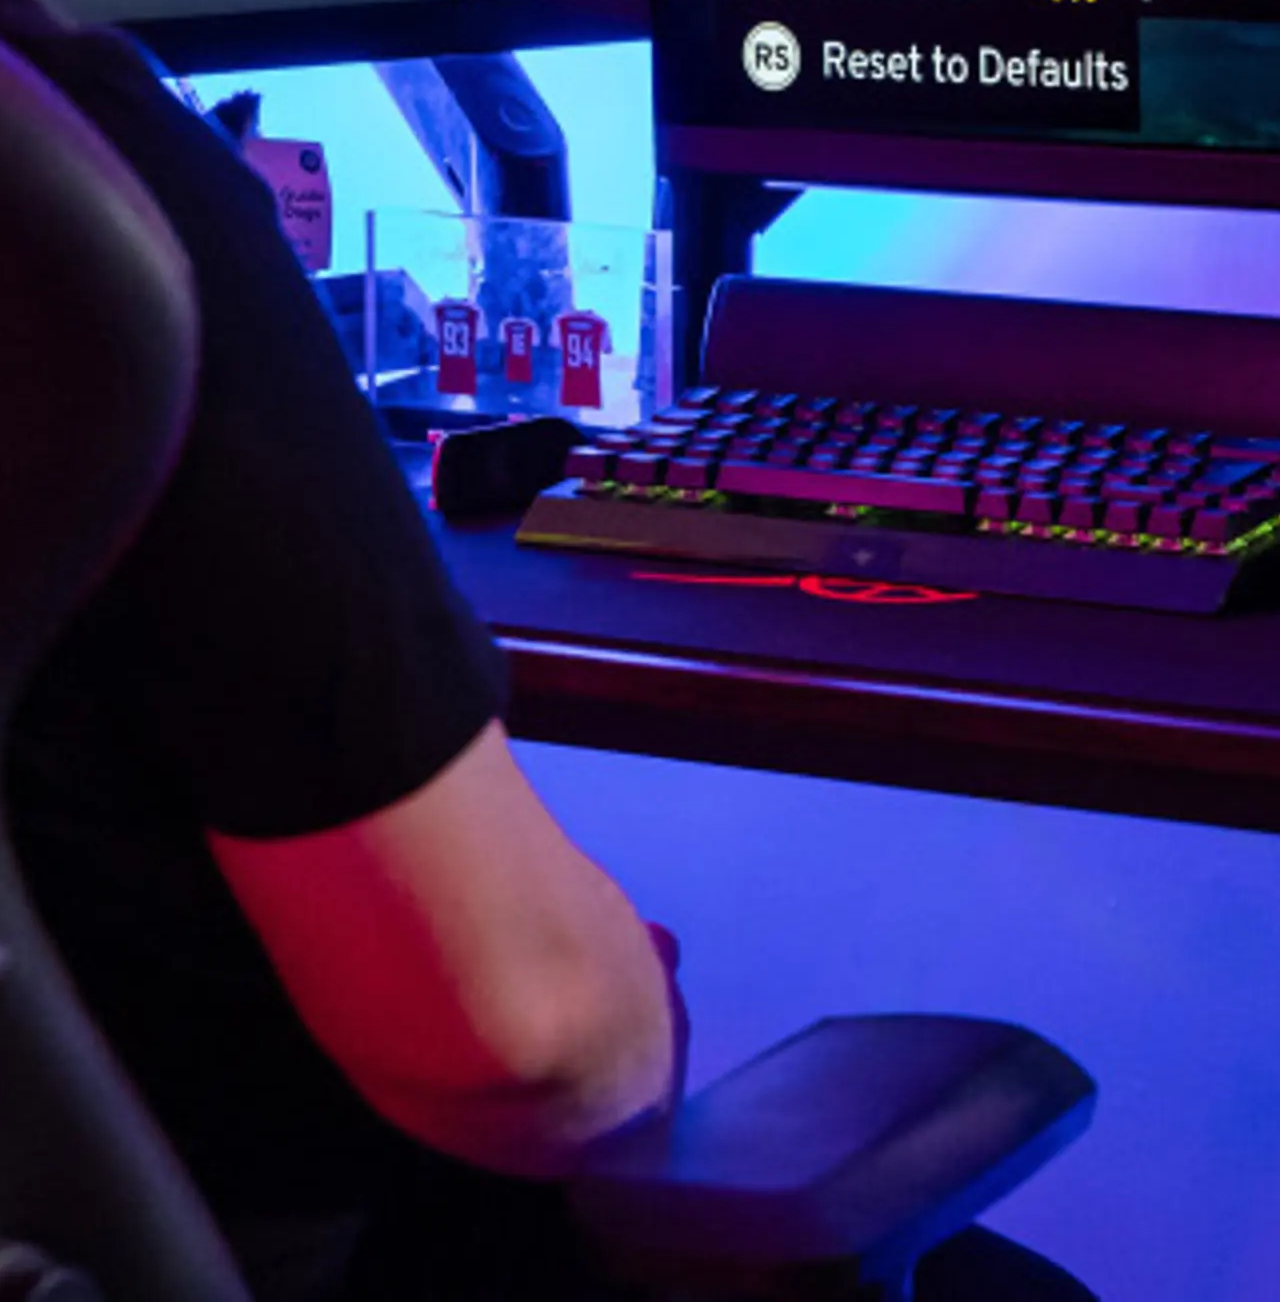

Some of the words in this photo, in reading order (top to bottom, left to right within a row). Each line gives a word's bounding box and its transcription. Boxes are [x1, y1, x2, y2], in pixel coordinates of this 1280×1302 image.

[754, 42, 790, 71] RS
[823, 42, 923, 82] Reset
[932, 45, 969, 84] to
[979, 47, 1130, 91] Defaults
[444, 320, 469, 357] 93
[568, 333, 593, 368] 94
